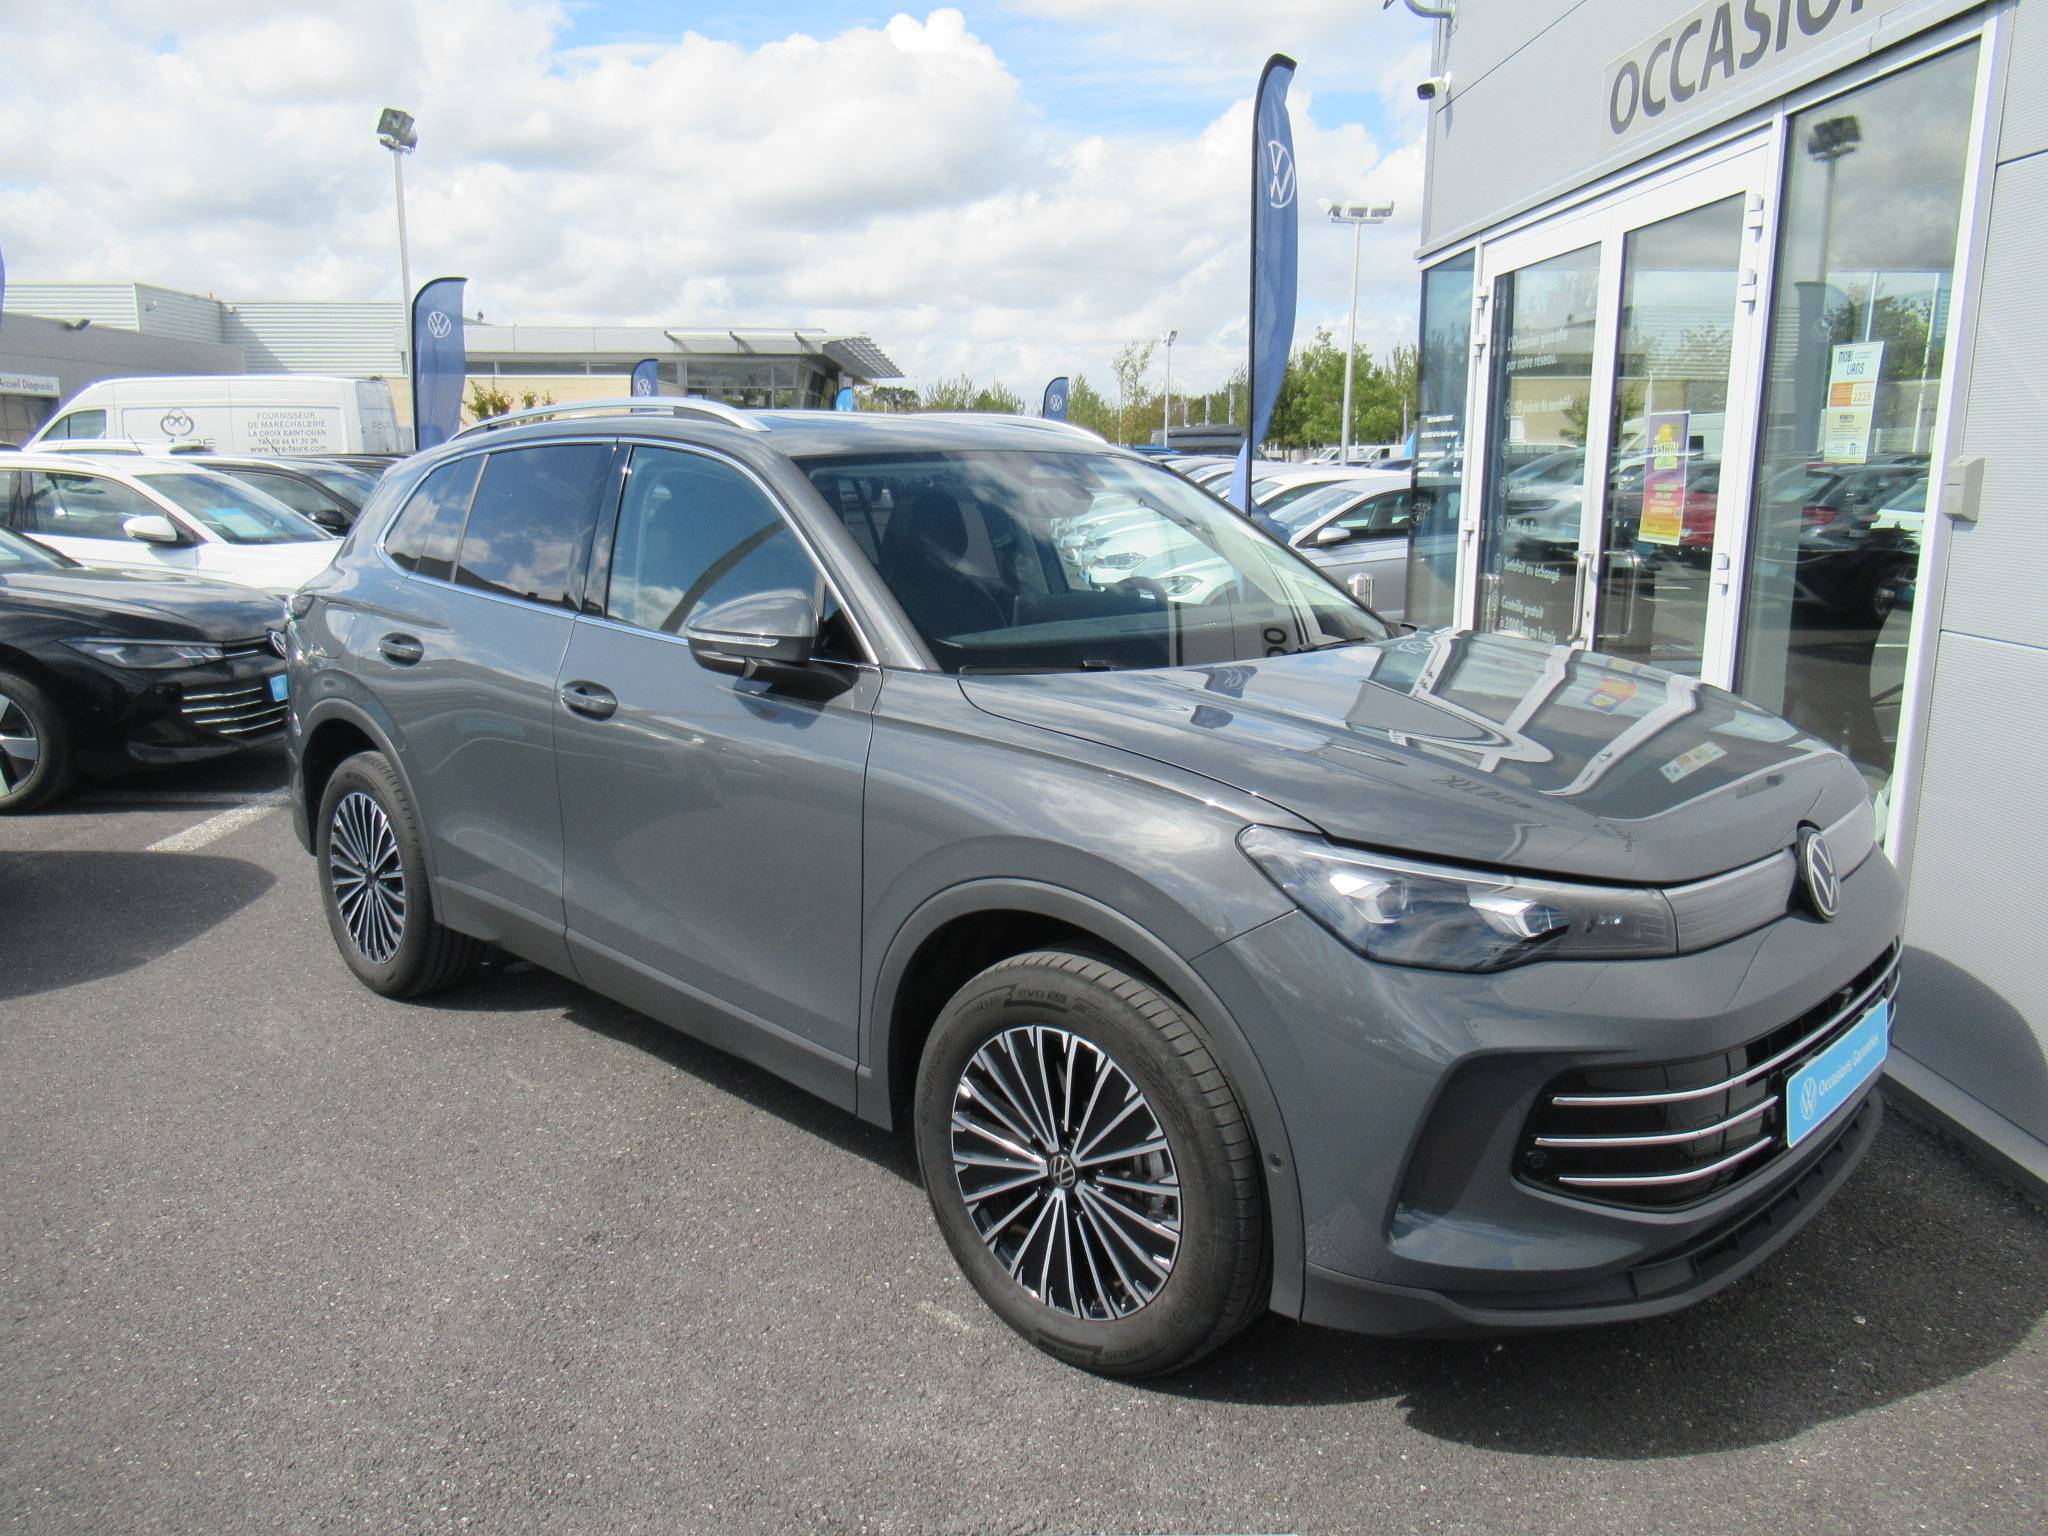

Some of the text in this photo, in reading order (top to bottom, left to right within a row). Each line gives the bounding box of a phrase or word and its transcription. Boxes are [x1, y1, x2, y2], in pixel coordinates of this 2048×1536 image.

[1610, 0, 1863, 134] OCCASI
[1506, 361, 1517, 375] par
[1518, 356, 1533, 369] notre
[257, 412, 316, 420] FOURNISSEUR
[248, 421, 259, 429] DE
